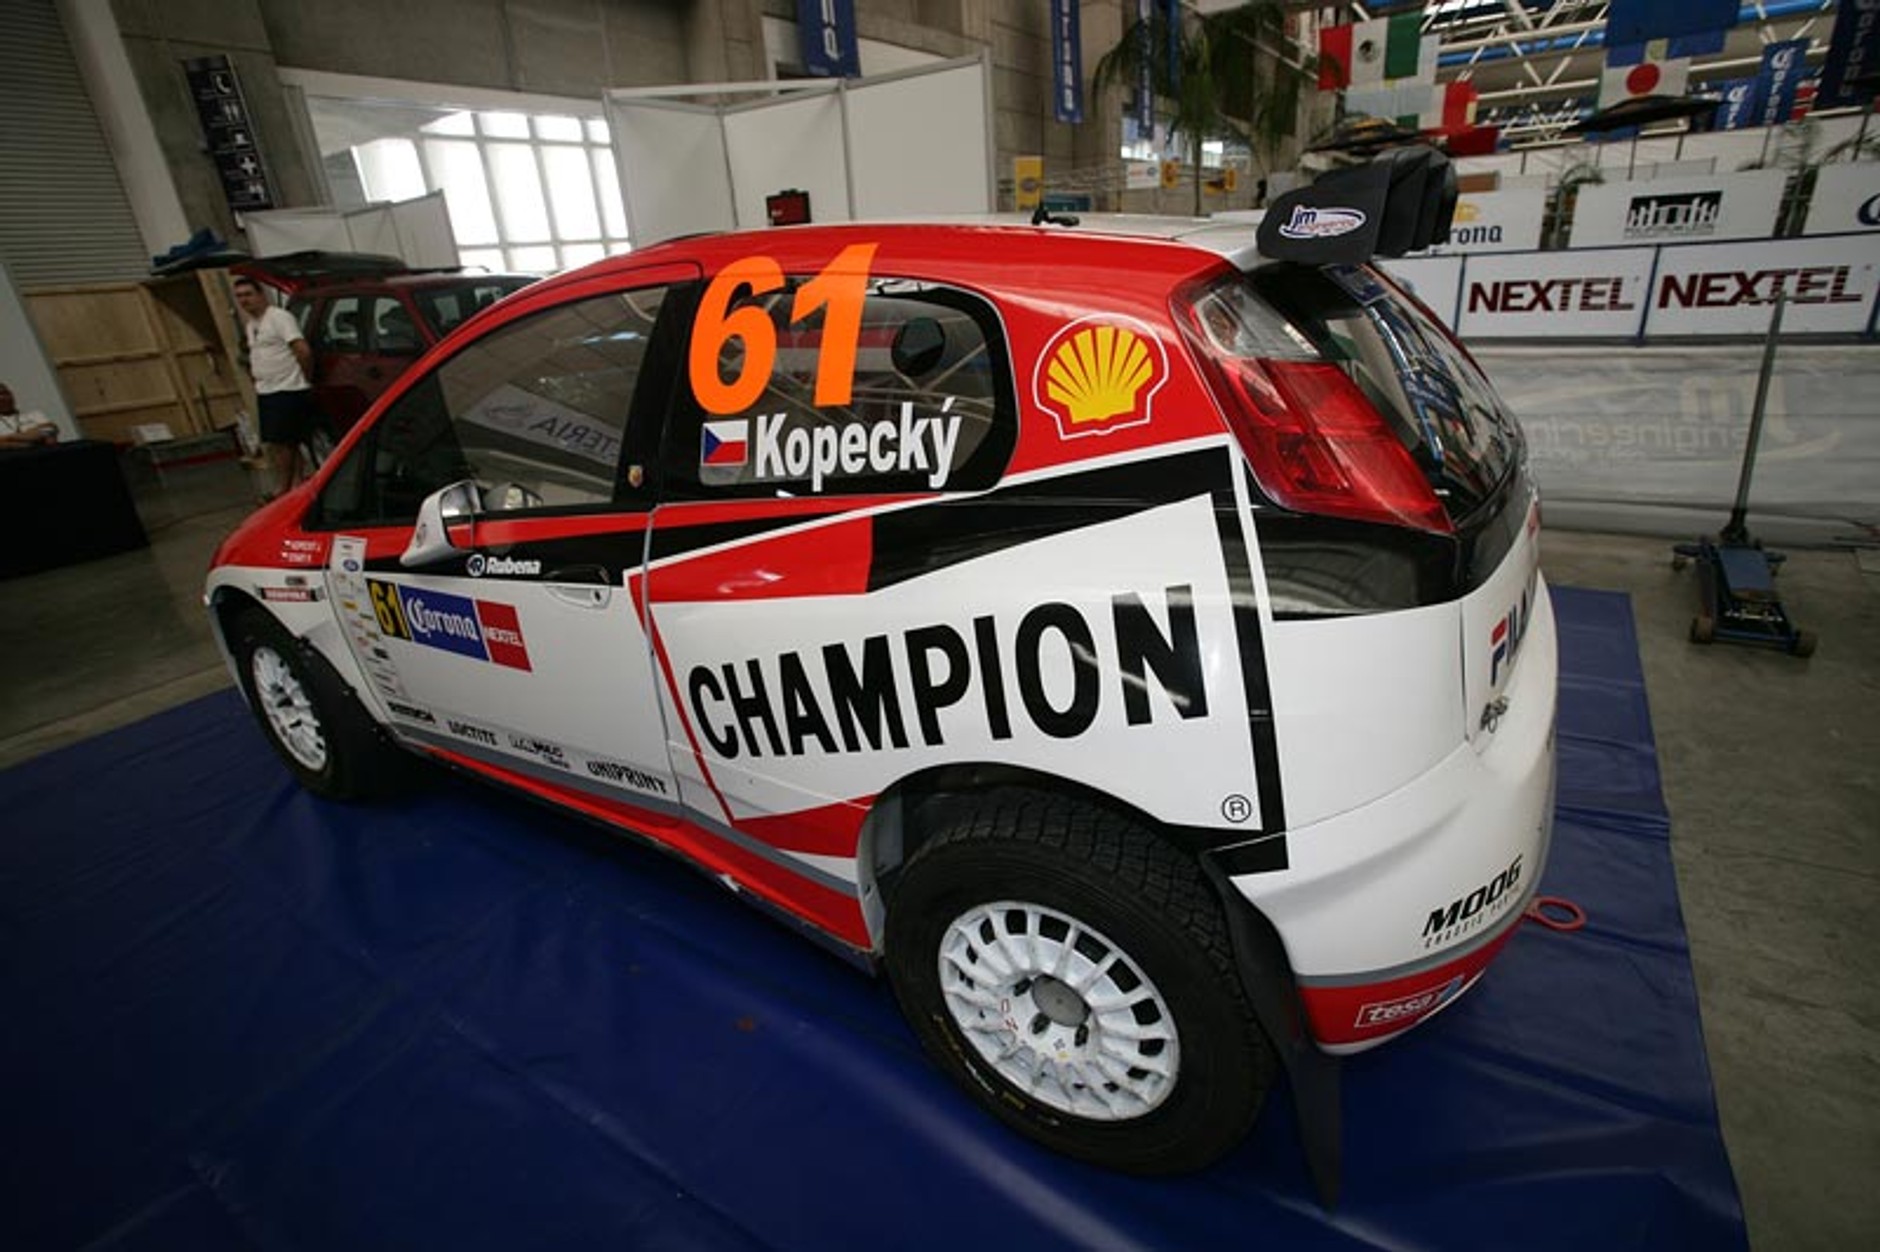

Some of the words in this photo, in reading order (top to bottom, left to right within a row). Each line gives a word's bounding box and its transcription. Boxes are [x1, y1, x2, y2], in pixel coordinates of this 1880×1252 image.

[1467, 276, 1636, 313] NEXTEL
[1657, 265, 1864, 310] NEXTEL
[689, 243, 880, 415] 61
[755, 396, 962, 493] Kopecký
[486, 556, 541, 575] Rubena
[371, 582, 411, 642] 61
[407, 597, 479, 641] Corona
[484, 625, 524, 648] NEXTEL
[687, 583, 1209, 759] CHAMPION
[1422, 853, 1524, 938] MOOG
